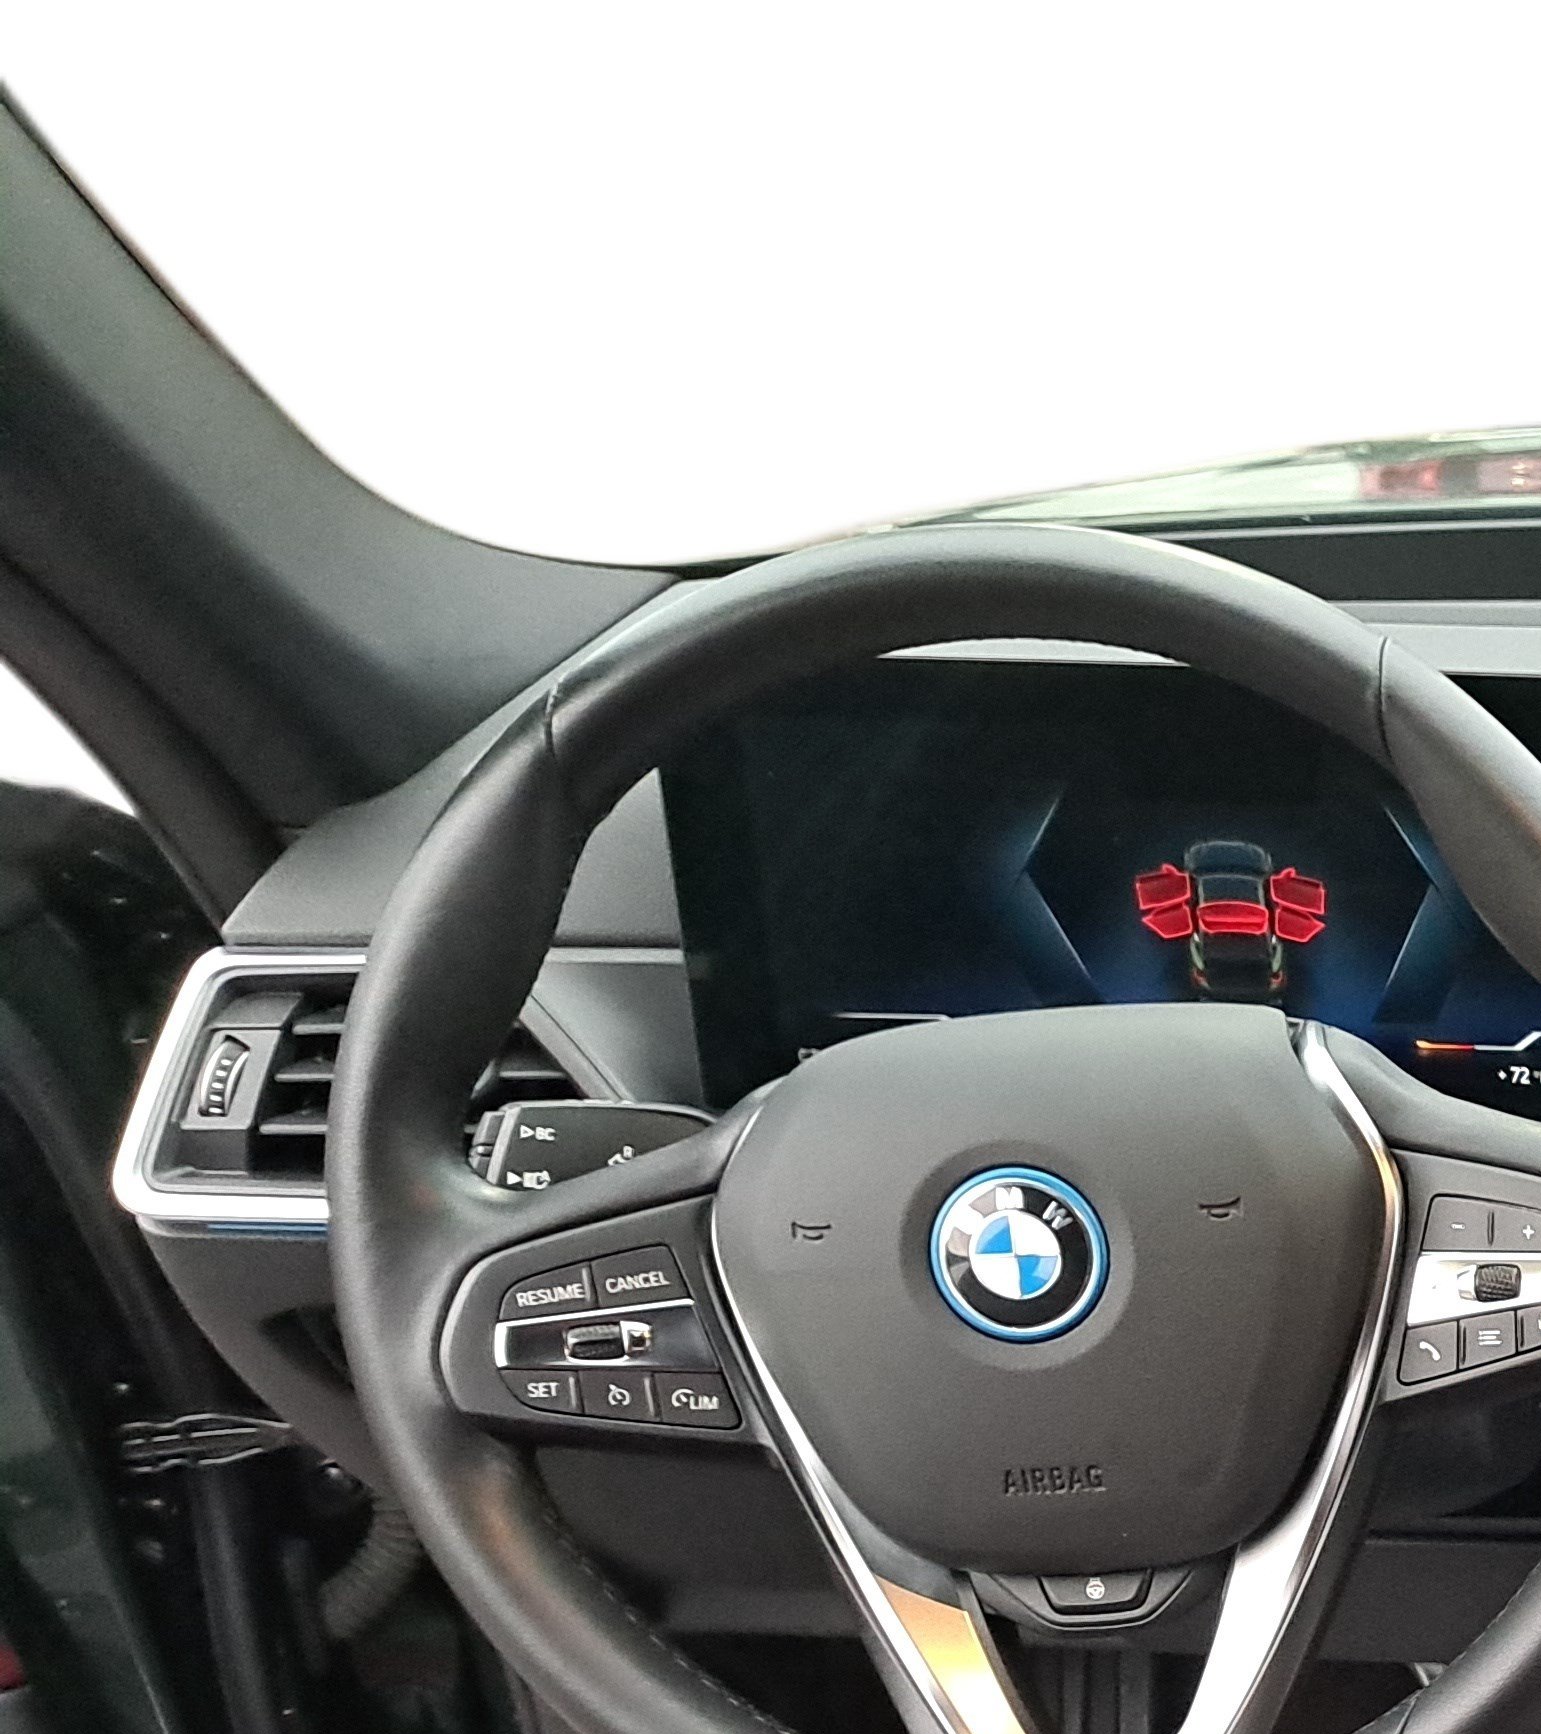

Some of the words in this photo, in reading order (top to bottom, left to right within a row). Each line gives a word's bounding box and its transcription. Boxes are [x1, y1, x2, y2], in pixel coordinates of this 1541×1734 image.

[605, 1271, 671, 1294] CANCEL
[516, 1283, 585, 1307] RESUME
[527, 1382, 560, 1398] SET
[689, 1395, 720, 1411] LIM
[1004, 1465, 1106, 1496] AIRBAG
